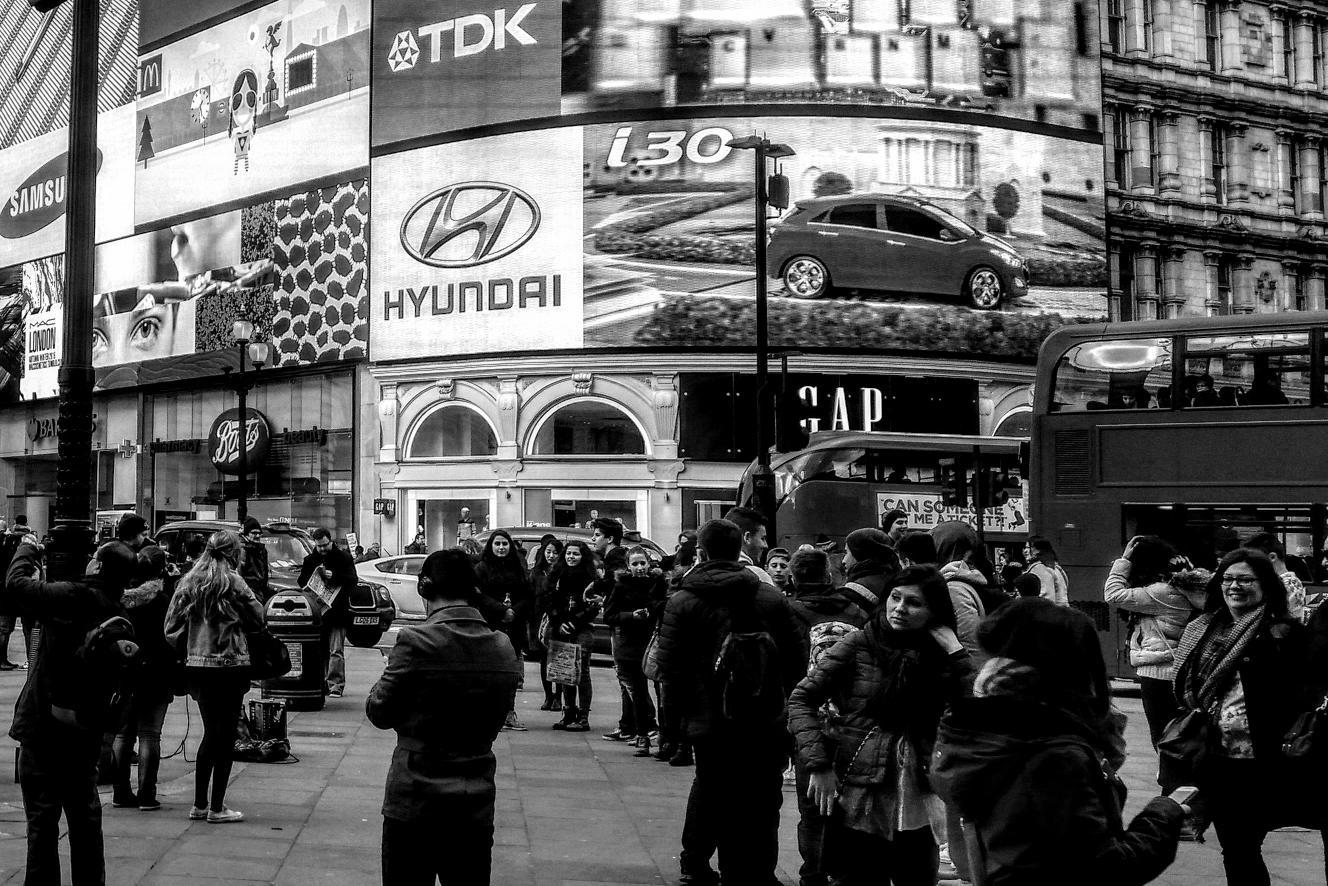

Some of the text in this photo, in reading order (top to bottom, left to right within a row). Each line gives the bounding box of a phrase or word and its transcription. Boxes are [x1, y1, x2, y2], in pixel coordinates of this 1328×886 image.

[418, 3, 538, 63] TDK
[606, 126, 734, 167] i30
[9, 175, 66, 217] SAMSU
[384, 274, 562, 321] HYUNDAI
[29, 326, 57, 353] LONDON
[798, 386, 883, 433] GAP
[212, 418, 260, 464] Bots
[914, 514, 934, 525] ME
